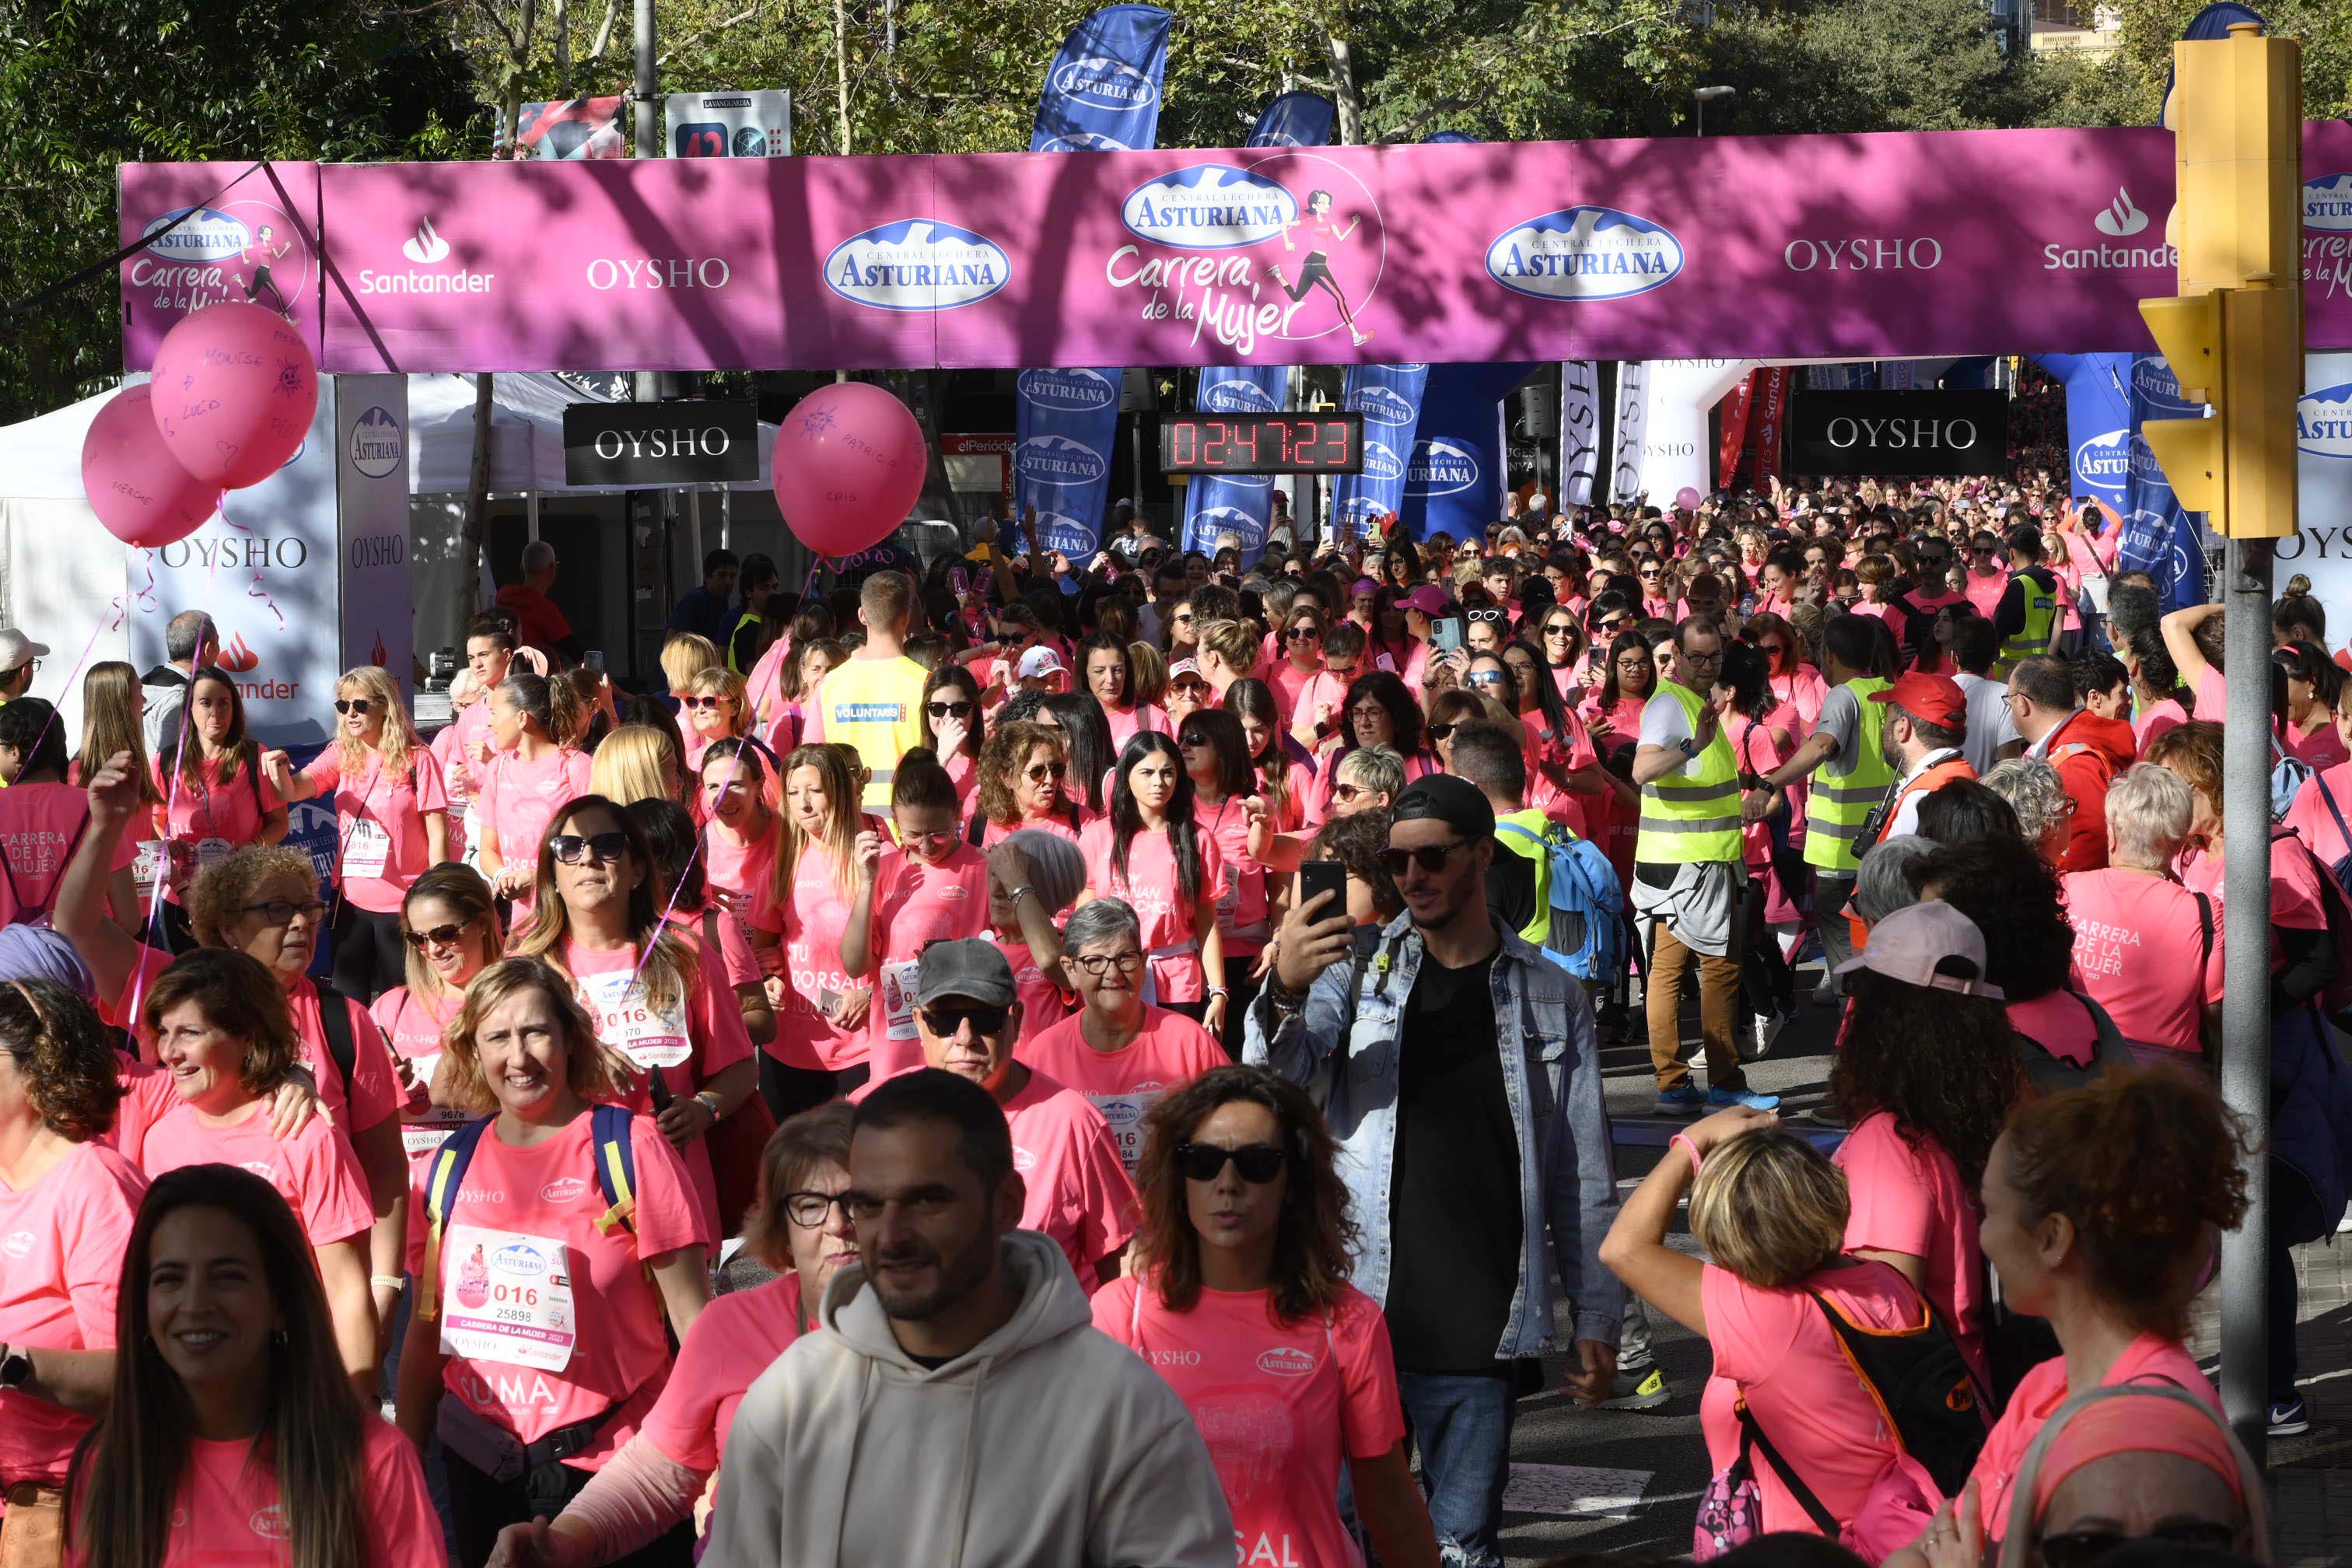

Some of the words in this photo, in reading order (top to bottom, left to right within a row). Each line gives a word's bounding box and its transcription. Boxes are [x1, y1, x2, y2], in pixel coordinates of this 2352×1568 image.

[1061, 70, 1146, 102] ASTURIANA
[1162, 194, 1218, 203] CENTRAL
[1222, 191, 1280, 202] LECHERA
[1135, 196, 1283, 229] ASTURIANA
[2302, 201, 2352, 217] STUR
[149, 229, 243, 248] ASTURIANA
[1531, 238, 1593, 249] CENTRAL
[1598, 236, 1662, 247] LECHERA
[866, 250, 926, 260] CENTRAL
[1500, 243, 1669, 278] ASTURIANA
[1784, 236, 1943, 271] OYSHO
[2044, 243, 2179, 270] Santande
[131, 257, 223, 288] Carrera
[586, 257, 731, 291] OYSHO
[838, 253, 996, 287] ASTURIANA
[1106, 244, 1251, 289] Carrera
[359, 268, 495, 294] Santander
[154, 289, 171, 309] de
[174, 288, 187, 310] la
[1141, 290, 1169, 320] de
[1174, 289, 1195, 320] la
[1189, 282, 1307, 356] Mujer
[1026, 374, 1105, 403] ASTURIANA
[1349, 395, 1408, 422] ASTURIANA
[1568, 360, 1597, 506] OYSH
[1616, 360, 1643, 500] OYSH
[1826, 418, 1977, 450] OYSHO
[355, 433, 399, 460] ASTURIANA
[594, 426, 730, 460] OYSHO
[957, 439, 1017, 453] elPeriódi
[1174, 422, 1349, 465] 02:47:23
[1644, 443, 1694, 457] YSHO
[1020, 449, 1097, 477] ASTURIANA
[1363, 459, 1397, 476] URIANA
[1430, 457, 1468, 467] LECHERA
[2081, 452, 2128, 474] ASTU
[160, 537, 308, 569] OYSHO
[351, 534, 404, 569] OYSHO
[836, 708, 898, 718] VOLUNTARIS
[0, 831, 67, 848] CARRERA
[12, 846, 32, 859] DE
[37, 845, 54, 859] LA
[10, 859, 58, 873] MUJER
[135, 865, 149, 874] 16
[2074, 933, 2098, 953] DE
[2102, 941, 2122, 959] LA
[607, 1008, 647, 1027] 016
[394, 1032, 439, 1044] OYSHO
[408, 1136, 442, 1146] OYSHO
[1115, 1132, 1136, 1146] 16
[547, 1186, 586, 1199] ASTURIANA
[495, 1253, 543, 1271] ASTURIANA
[494, 1284, 537, 1306] 016
[496, 1307, 532, 1323] 25898
[460, 1320, 498, 1332] CARRERA
[499, 1324, 510, 1333] DE
[510, 1326, 521, 1335] LA
[521, 1328, 548, 1340] MUJER
[548, 1333, 565, 1343] 2023
[455, 1335, 498, 1351] OYSHO
[528, 1346, 563, 1362] Santander
[1262, 1356, 1314, 1370] ASTURIANA
[460, 1374, 555, 1406] SUMA
